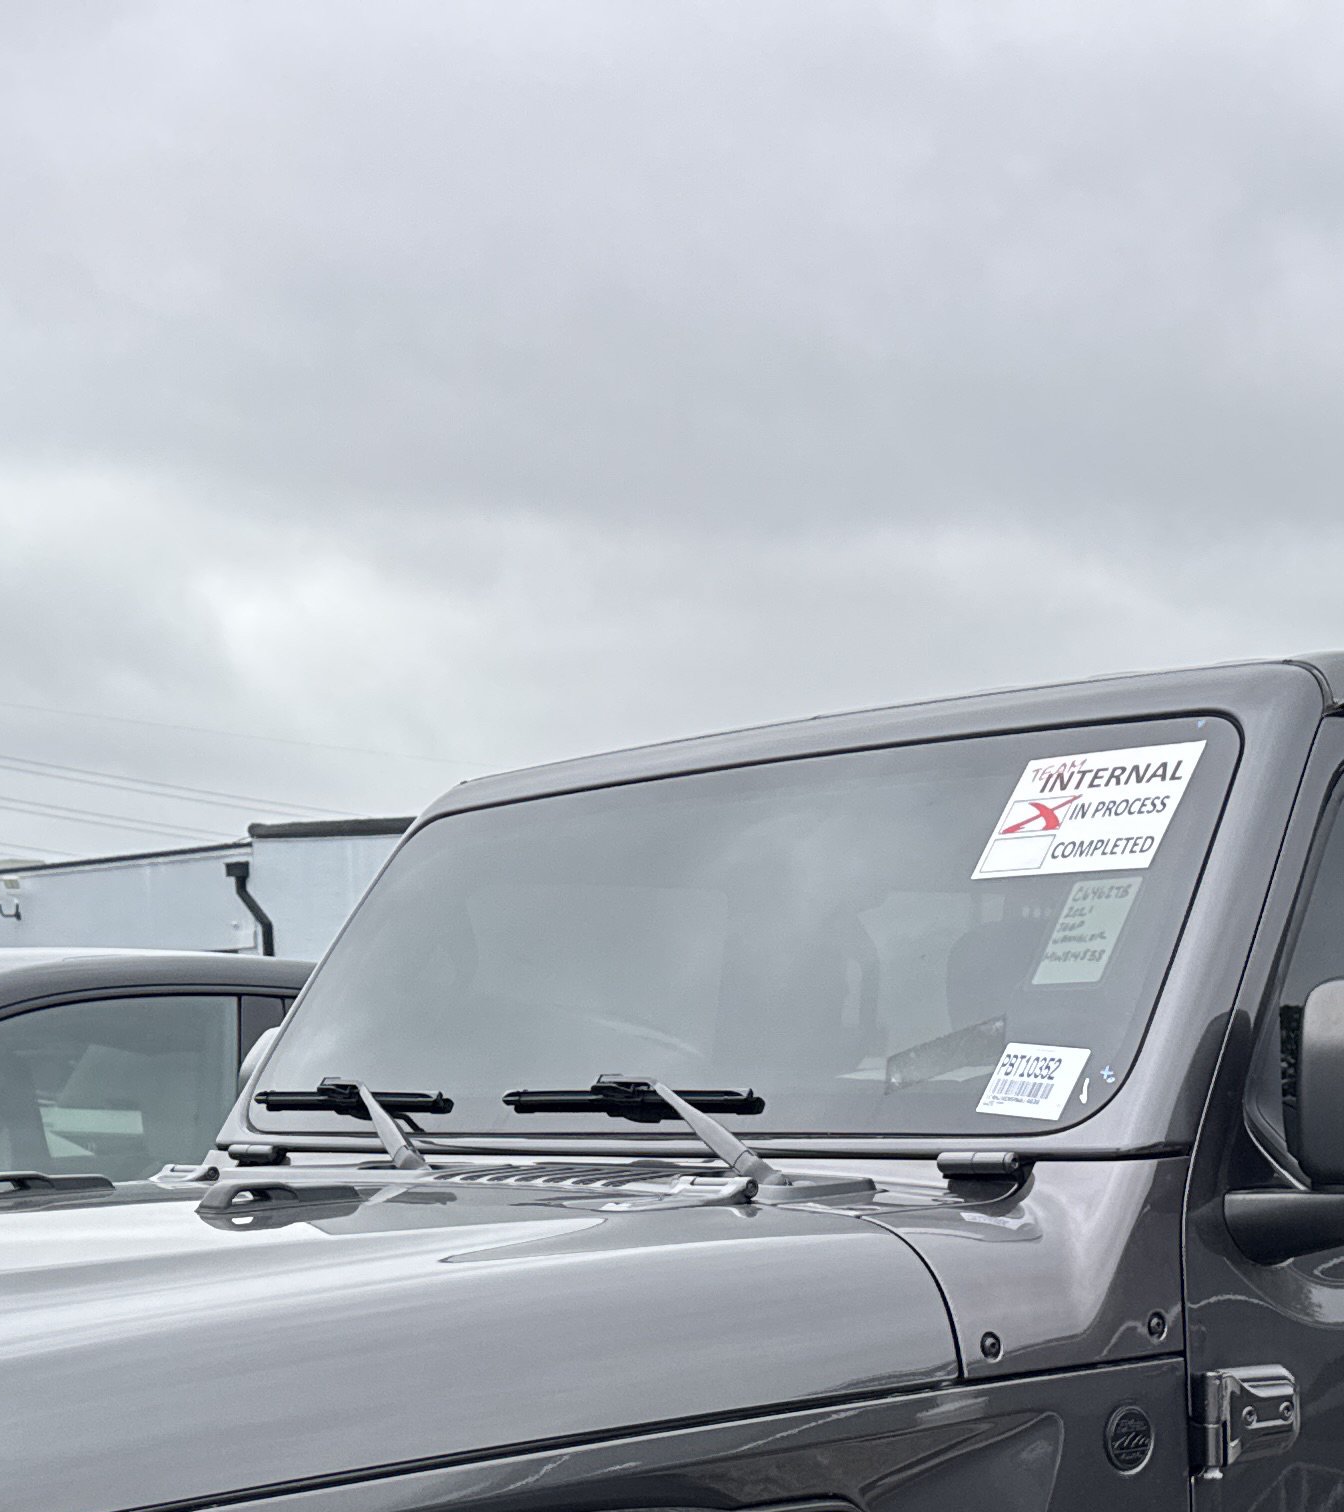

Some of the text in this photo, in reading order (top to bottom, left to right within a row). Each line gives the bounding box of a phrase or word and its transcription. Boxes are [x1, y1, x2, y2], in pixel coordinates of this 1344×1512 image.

[1039, 760, 1184, 794] INTERNAL
[1069, 795, 1171, 821] IN PROCESS
[1050, 835, 1155, 860] COMPLETED
[996, 1053, 1063, 1081] PBT10352
